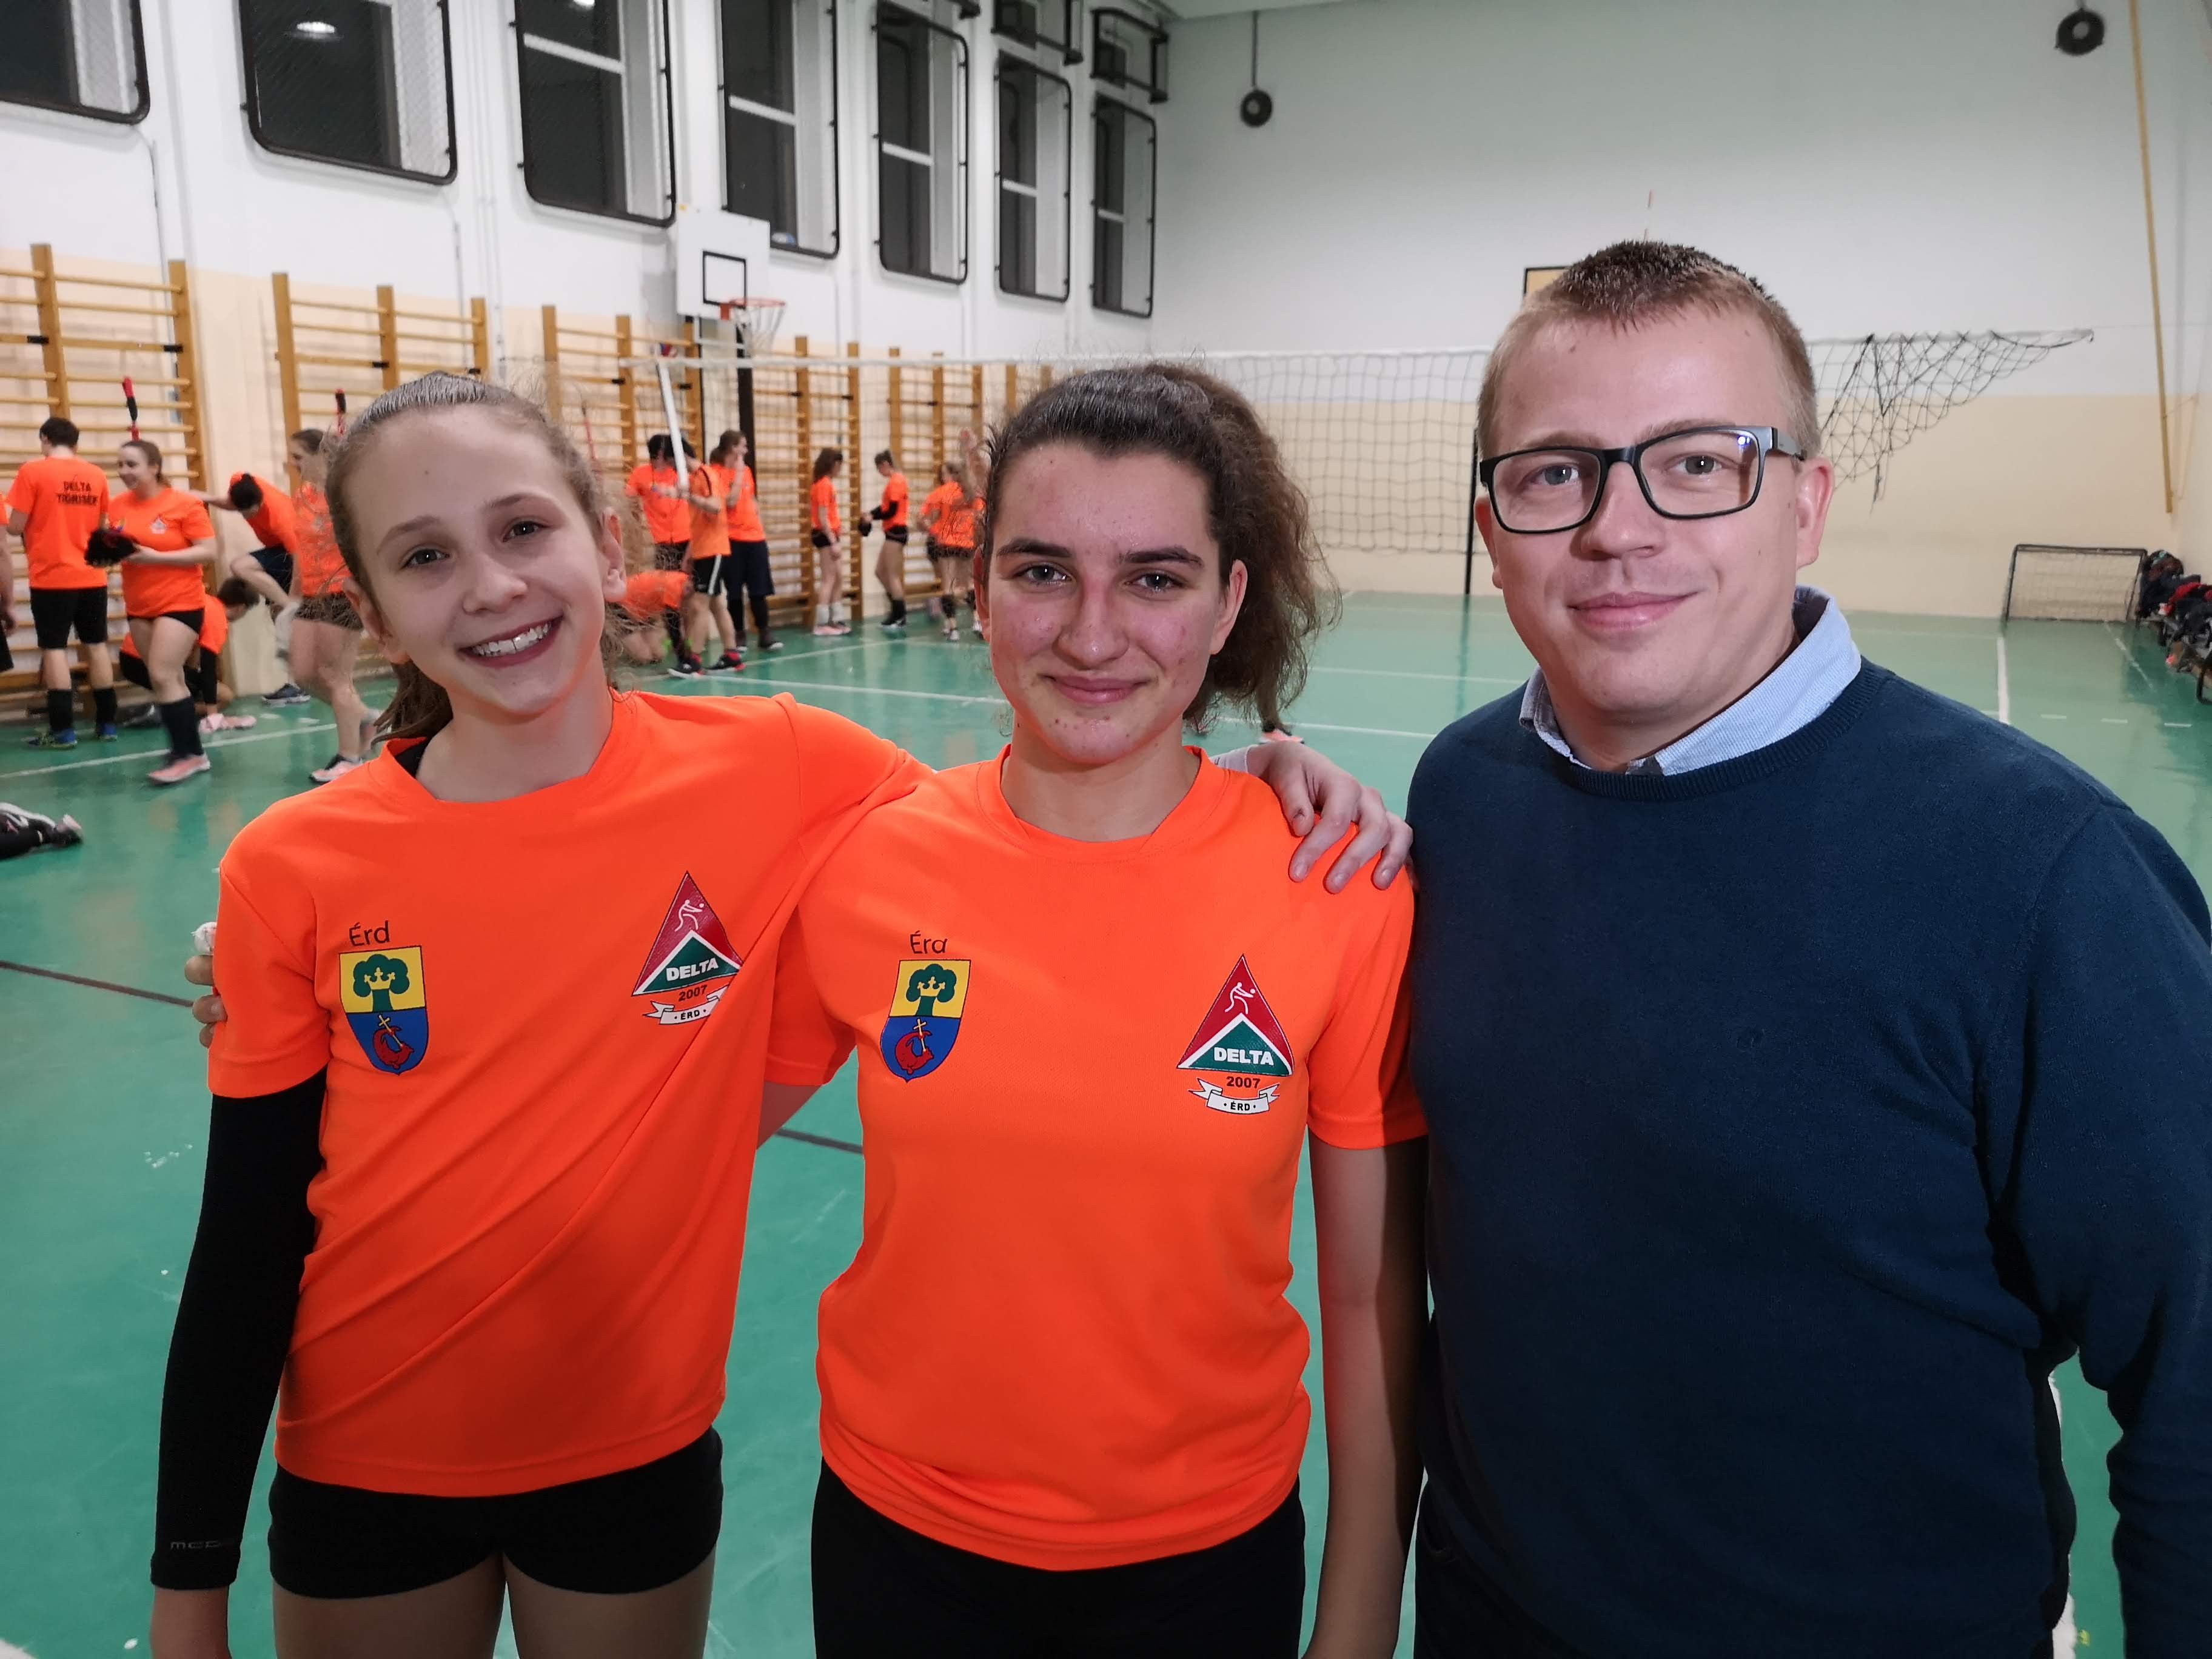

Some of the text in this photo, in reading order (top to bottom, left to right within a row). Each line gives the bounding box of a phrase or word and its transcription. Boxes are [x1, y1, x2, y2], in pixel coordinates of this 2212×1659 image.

[349, 920, 390, 947] Érd
[666, 958, 719, 981] DELTA
[679, 984, 708, 1002] 2007
[1214, 1047, 1274, 1065] DELTA
[1226, 1076, 1261, 1088] 2007
